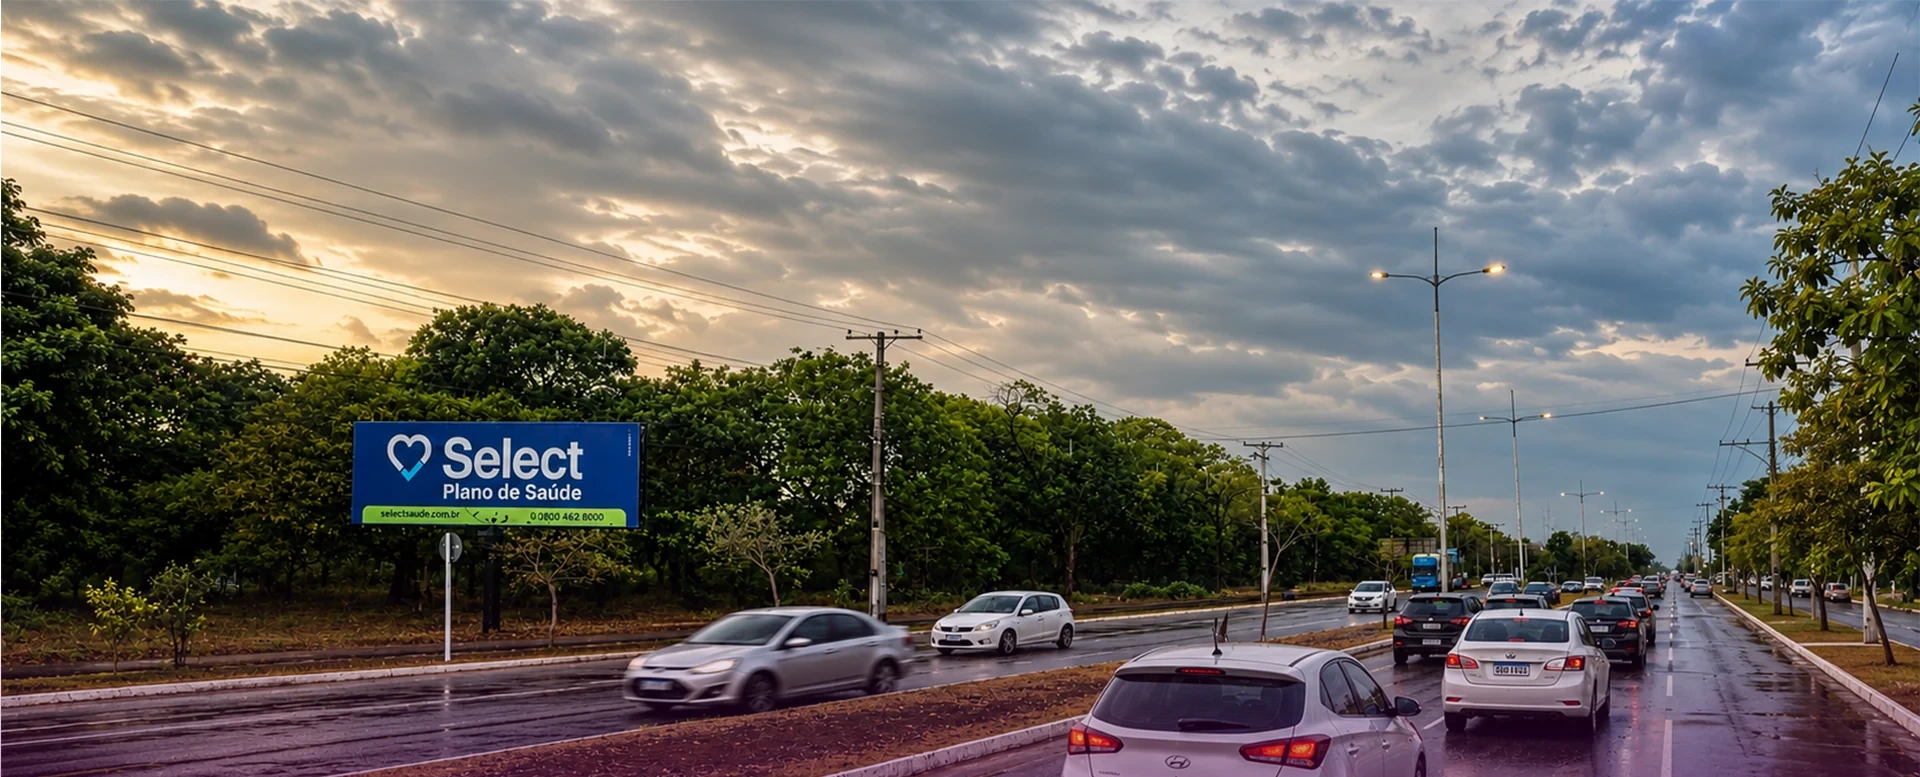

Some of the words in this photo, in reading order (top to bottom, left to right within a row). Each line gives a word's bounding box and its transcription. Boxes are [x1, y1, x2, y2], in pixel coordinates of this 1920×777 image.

[442, 436, 584, 480] Select
[443, 483, 494, 500] Plano
[497, 483, 520, 500] de
[525, 482, 582, 501] Saúde
